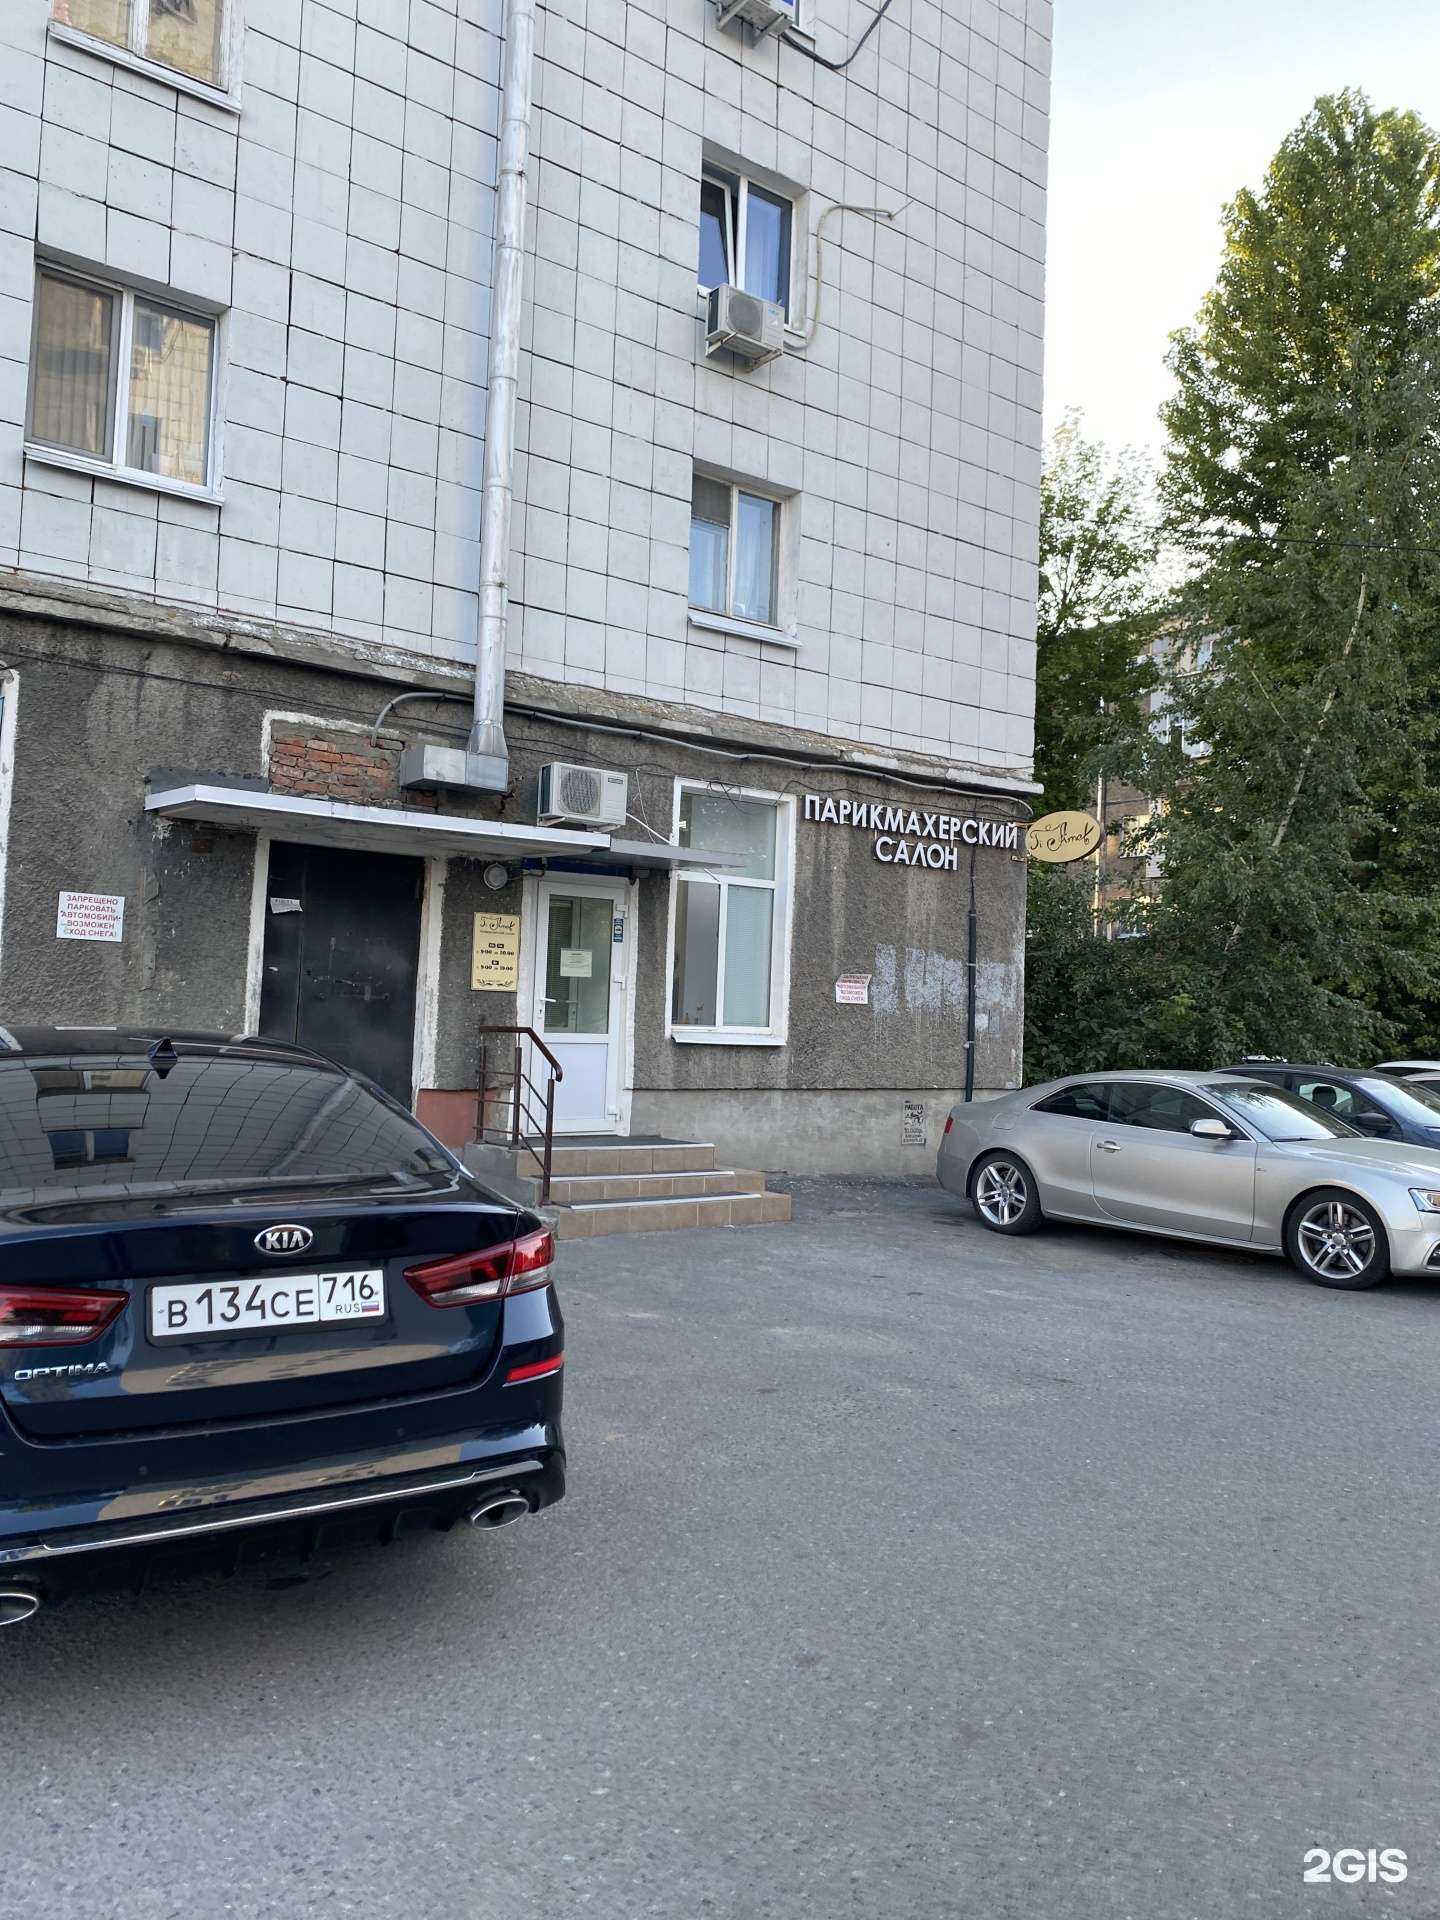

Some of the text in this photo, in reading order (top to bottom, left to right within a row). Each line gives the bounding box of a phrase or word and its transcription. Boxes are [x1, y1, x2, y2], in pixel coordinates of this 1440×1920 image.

[804, 794, 1018, 849] ПАРИКМАХЕРСКИЙ
[875, 836, 958, 871] САЛОН
[66, 895, 118, 905] ЗАПРЕЩЕНО
[67, 903, 116, 913] ПАРКОВАТЬ
[67, 920, 114, 929] ВОЗМОЖЕН
[265, 1230, 304, 1250] KIA
[322, 1274, 375, 1304] 716
[335, 1302, 361, 1314] RUS
[14, 1361, 112, 1381] OPTIMA
